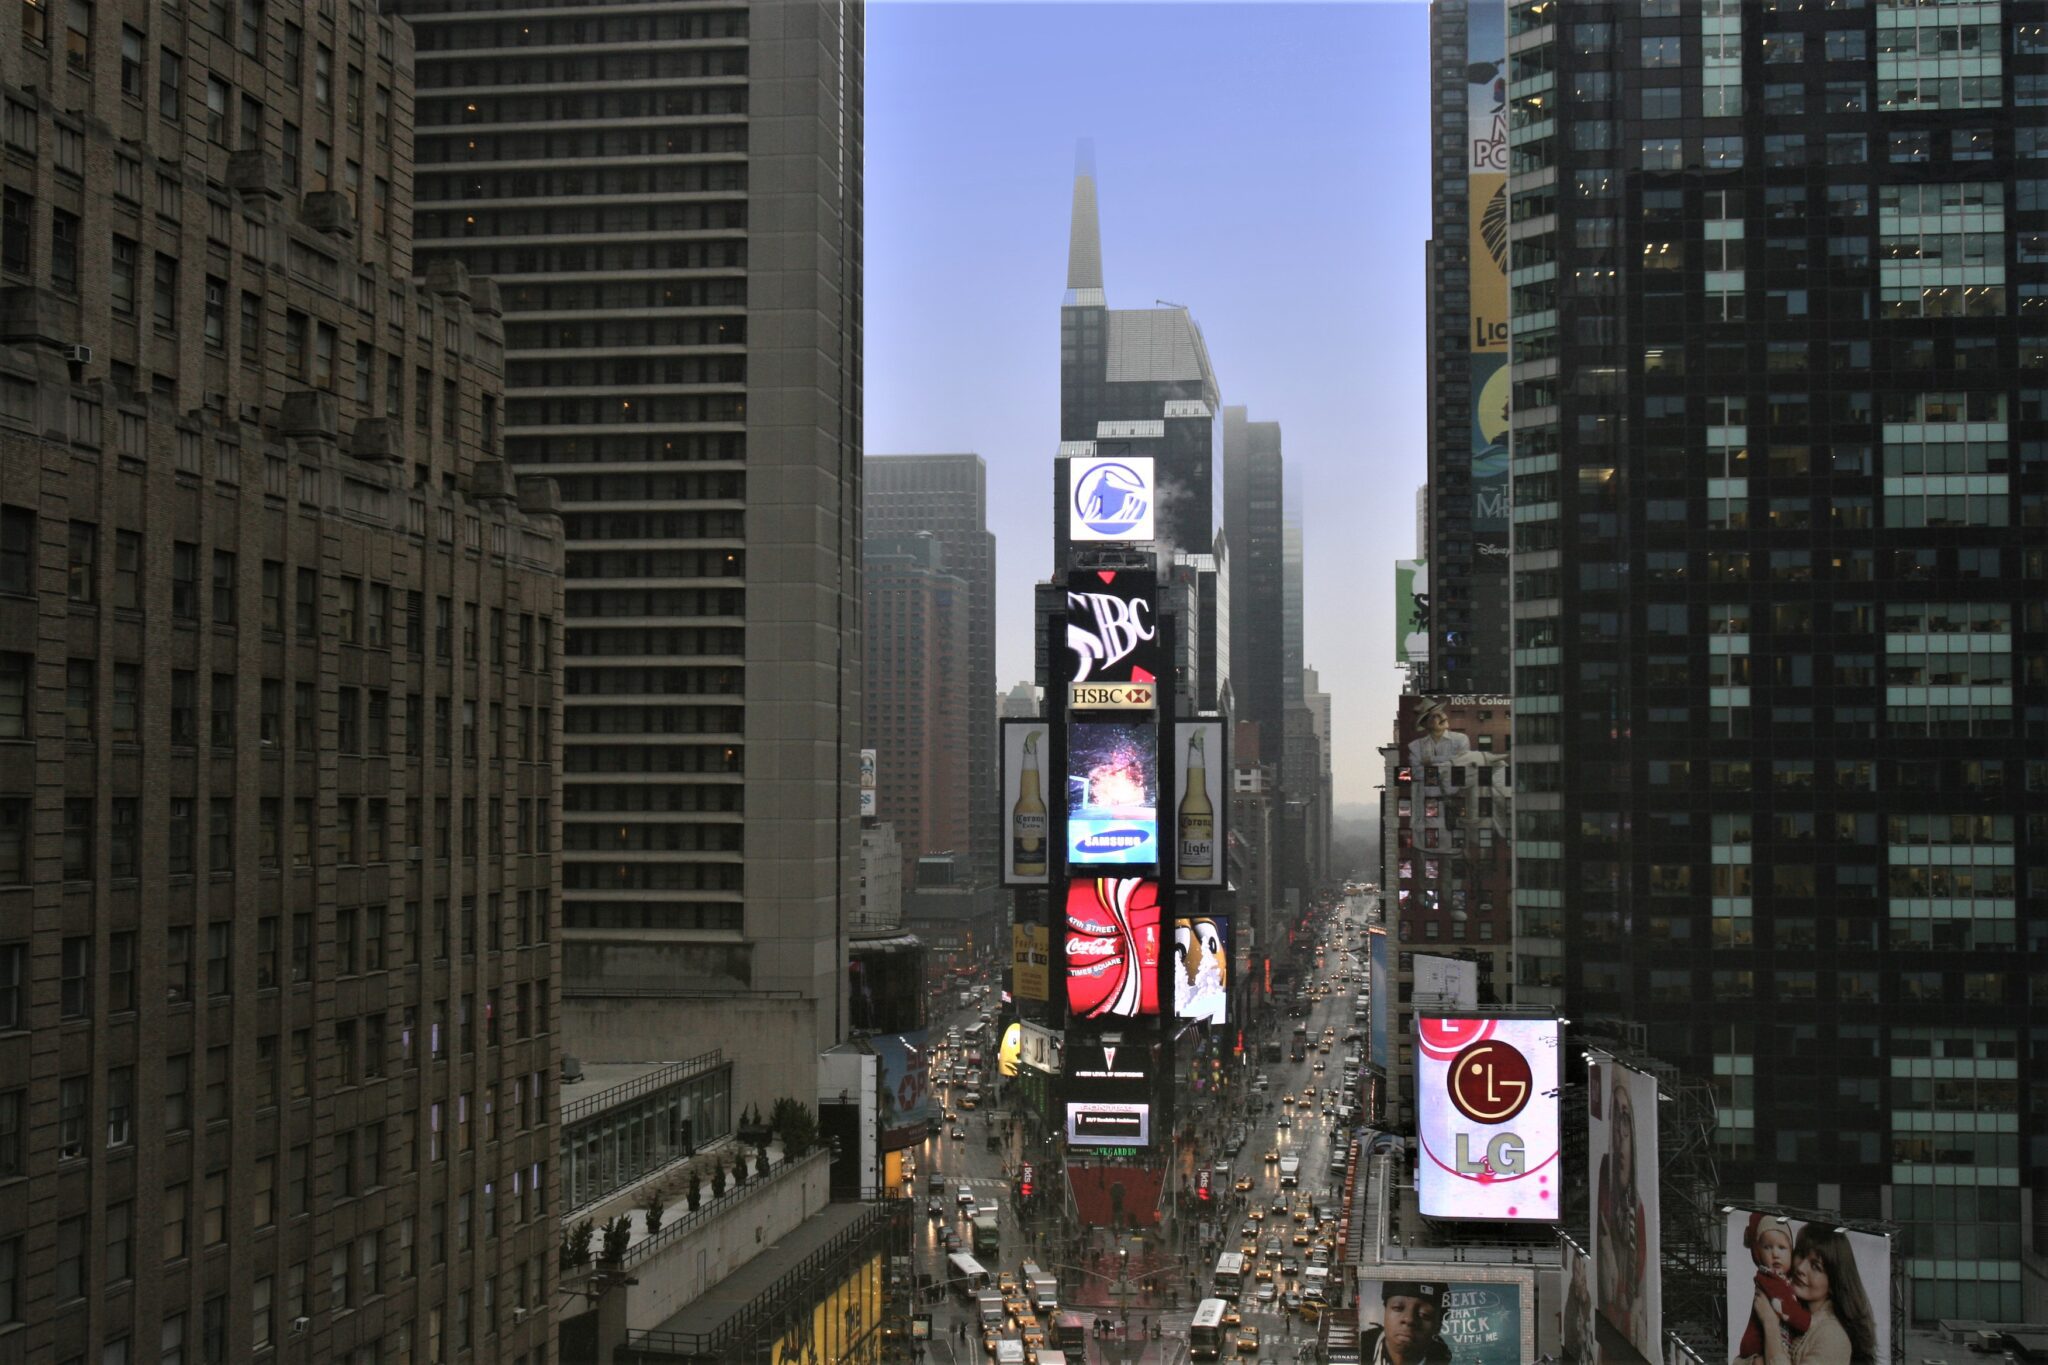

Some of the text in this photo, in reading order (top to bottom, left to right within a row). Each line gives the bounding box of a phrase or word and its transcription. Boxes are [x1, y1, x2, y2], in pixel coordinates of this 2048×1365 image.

[1072, 688, 1123, 703] HSBC
[1450, 696, 1476, 705] 100%
[1084, 836, 1141, 847] SAMSUNG
[1183, 841, 1210, 856] Light
[1085, 924, 1116, 933] STREET
[1066, 937, 1117, 955] Coca-Cola
[1070, 957, 1122, 977] TIMES SQUARE
[1455, 1132, 1526, 1175] LG
[1441, 1291, 1487, 1308] BEATS
[1448, 1307, 1478, 1319] THAT
[1440, 1317, 1490, 1335] STICK
[1453, 1332, 1499, 1343] WITH ME
